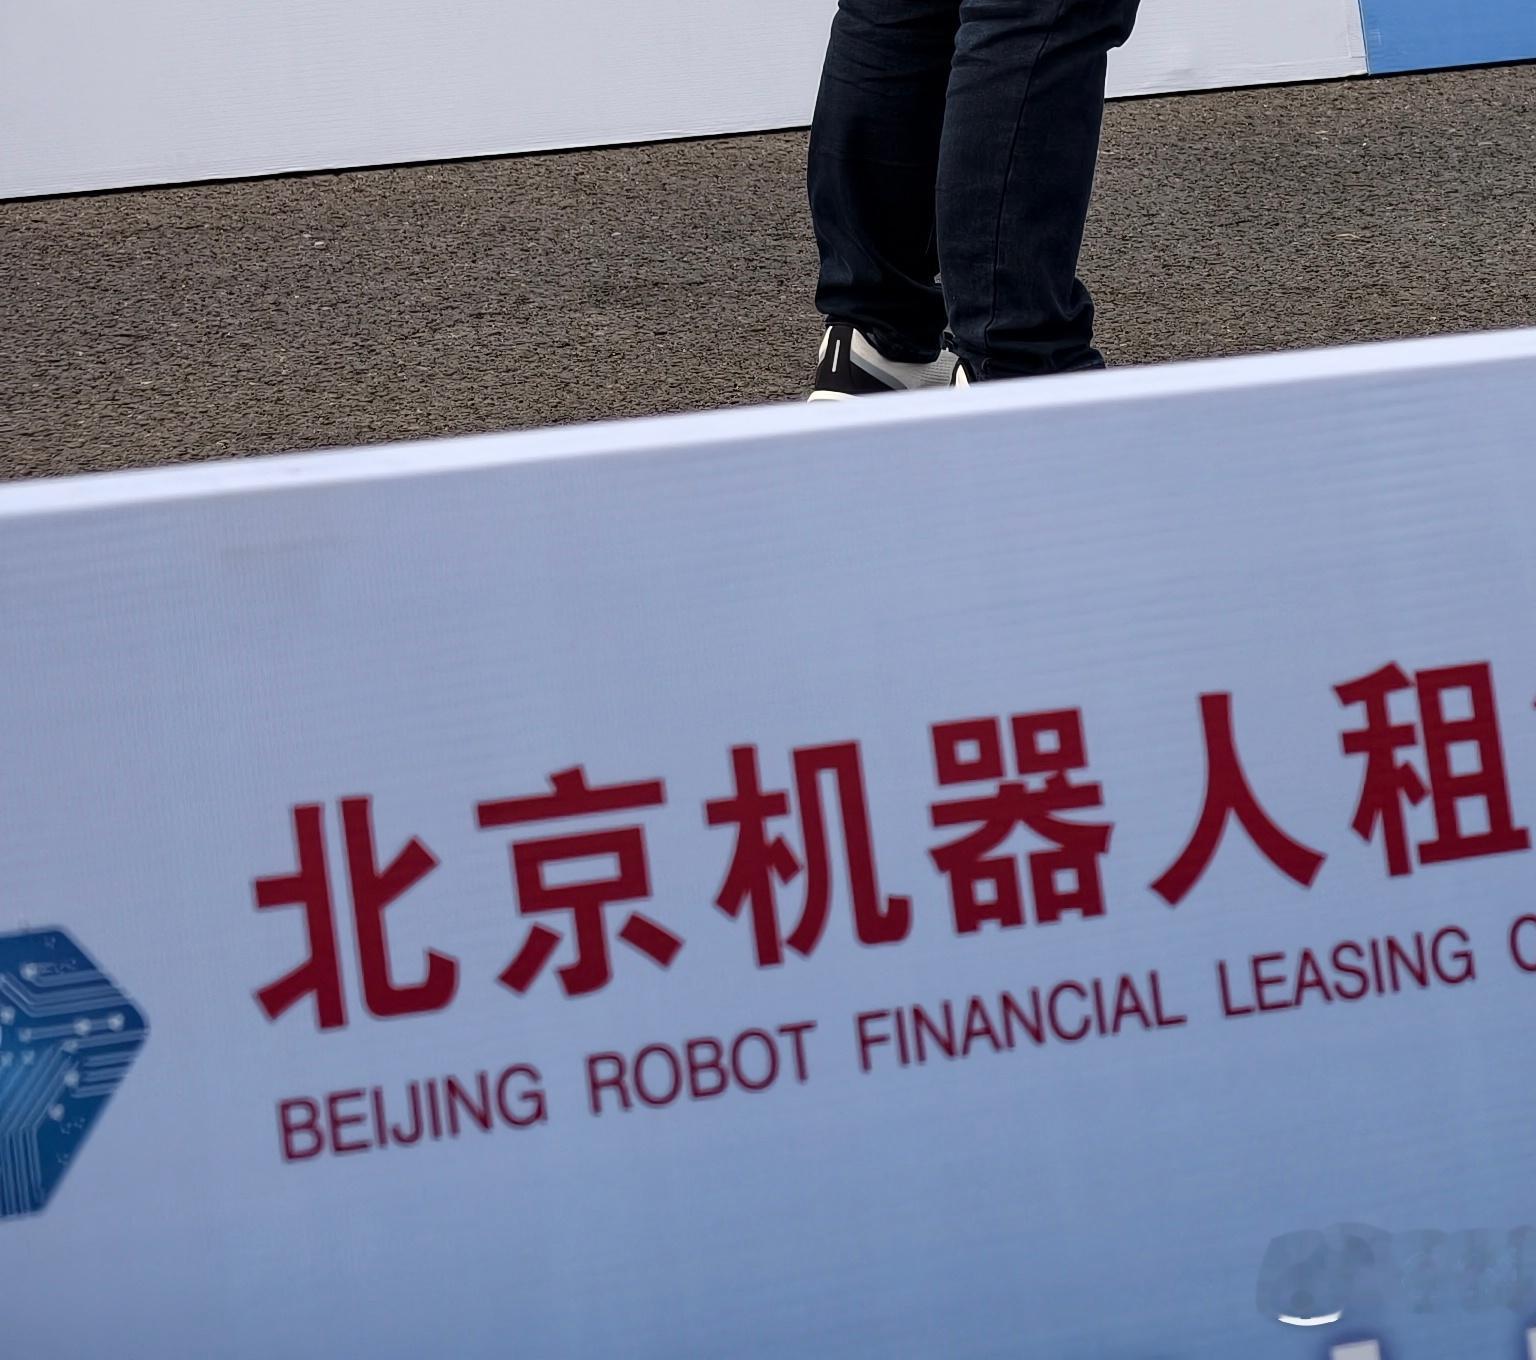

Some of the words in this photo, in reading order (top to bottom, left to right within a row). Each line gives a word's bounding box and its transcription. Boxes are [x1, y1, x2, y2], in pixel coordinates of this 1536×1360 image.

[276, 1063, 548, 1163] BEIJING
[584, 1020, 818, 1116] ROBOT
[854, 969, 1188, 1074] FINANCIAL
[1216, 925, 1476, 1019] LEASING
